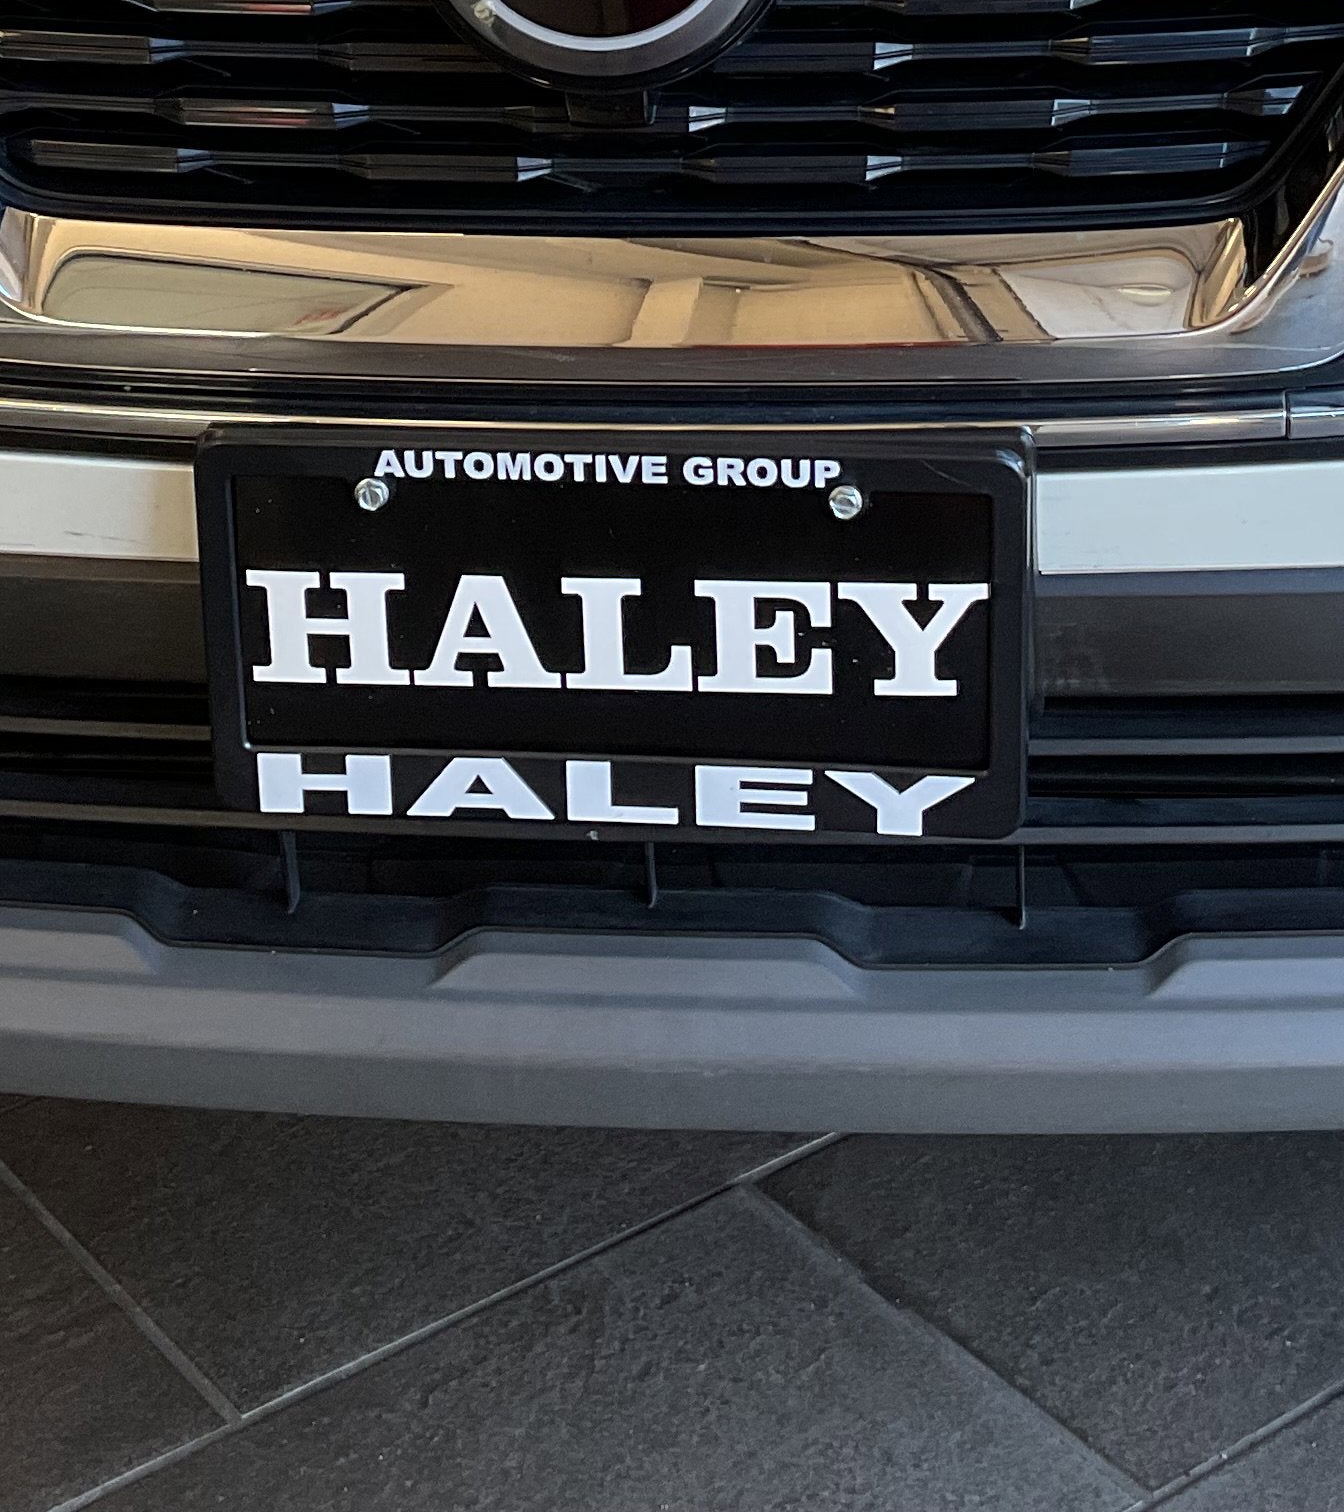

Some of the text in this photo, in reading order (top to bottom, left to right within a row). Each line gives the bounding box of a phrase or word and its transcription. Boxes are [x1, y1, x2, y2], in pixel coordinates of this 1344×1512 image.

[374, 449, 841, 489] AUTOMOTIVE GROUP
[245, 568, 990, 697] HALEY
[256, 752, 975, 837] HALEY
